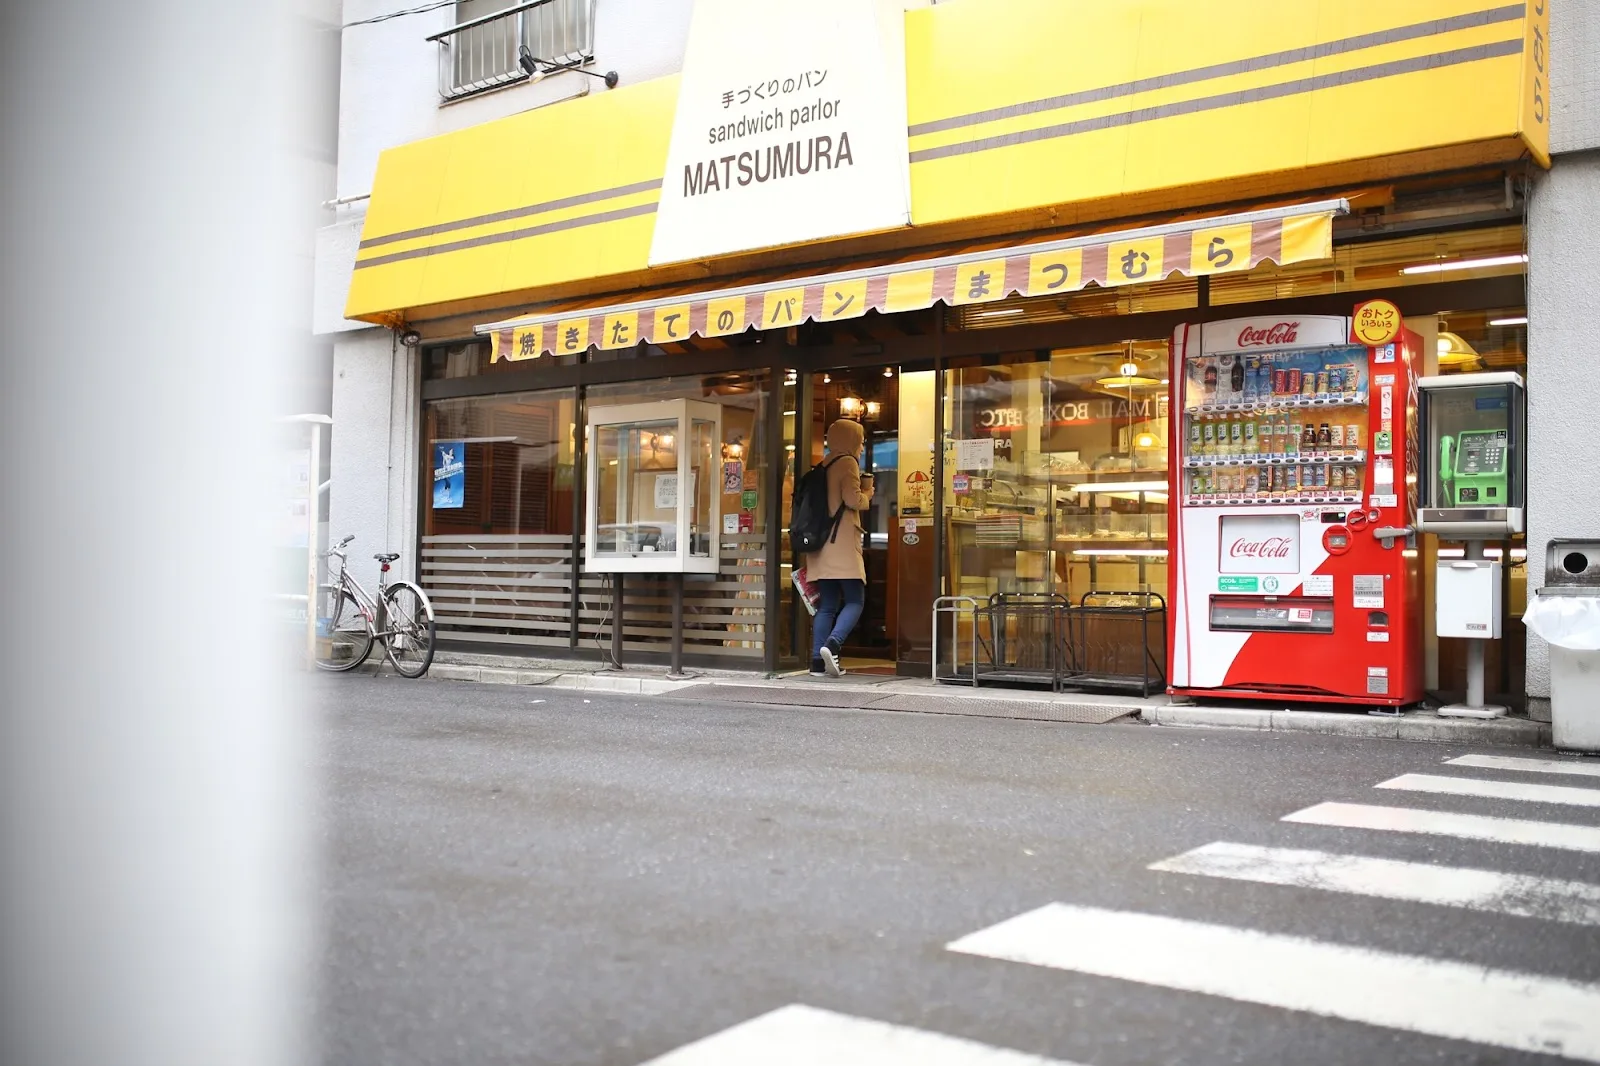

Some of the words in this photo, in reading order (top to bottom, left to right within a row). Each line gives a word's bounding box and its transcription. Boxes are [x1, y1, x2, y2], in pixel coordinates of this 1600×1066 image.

[721, 68, 828, 109] 手づくりのパン
[708, 107, 784, 144] sandwich
[789, 98, 841, 131] parlor
[683, 131, 854, 198] MATSUMURA
[518, 291, 855, 356] 焼きたてのパン
[967, 236, 1235, 299] まつむら
[1361, 319, 1392, 329] いろいろ
[1362, 308, 1394, 320] おトク
[1237, 321, 1300, 347] Coca-Cola
[1230, 537, 1293, 558] Coca-Cola
